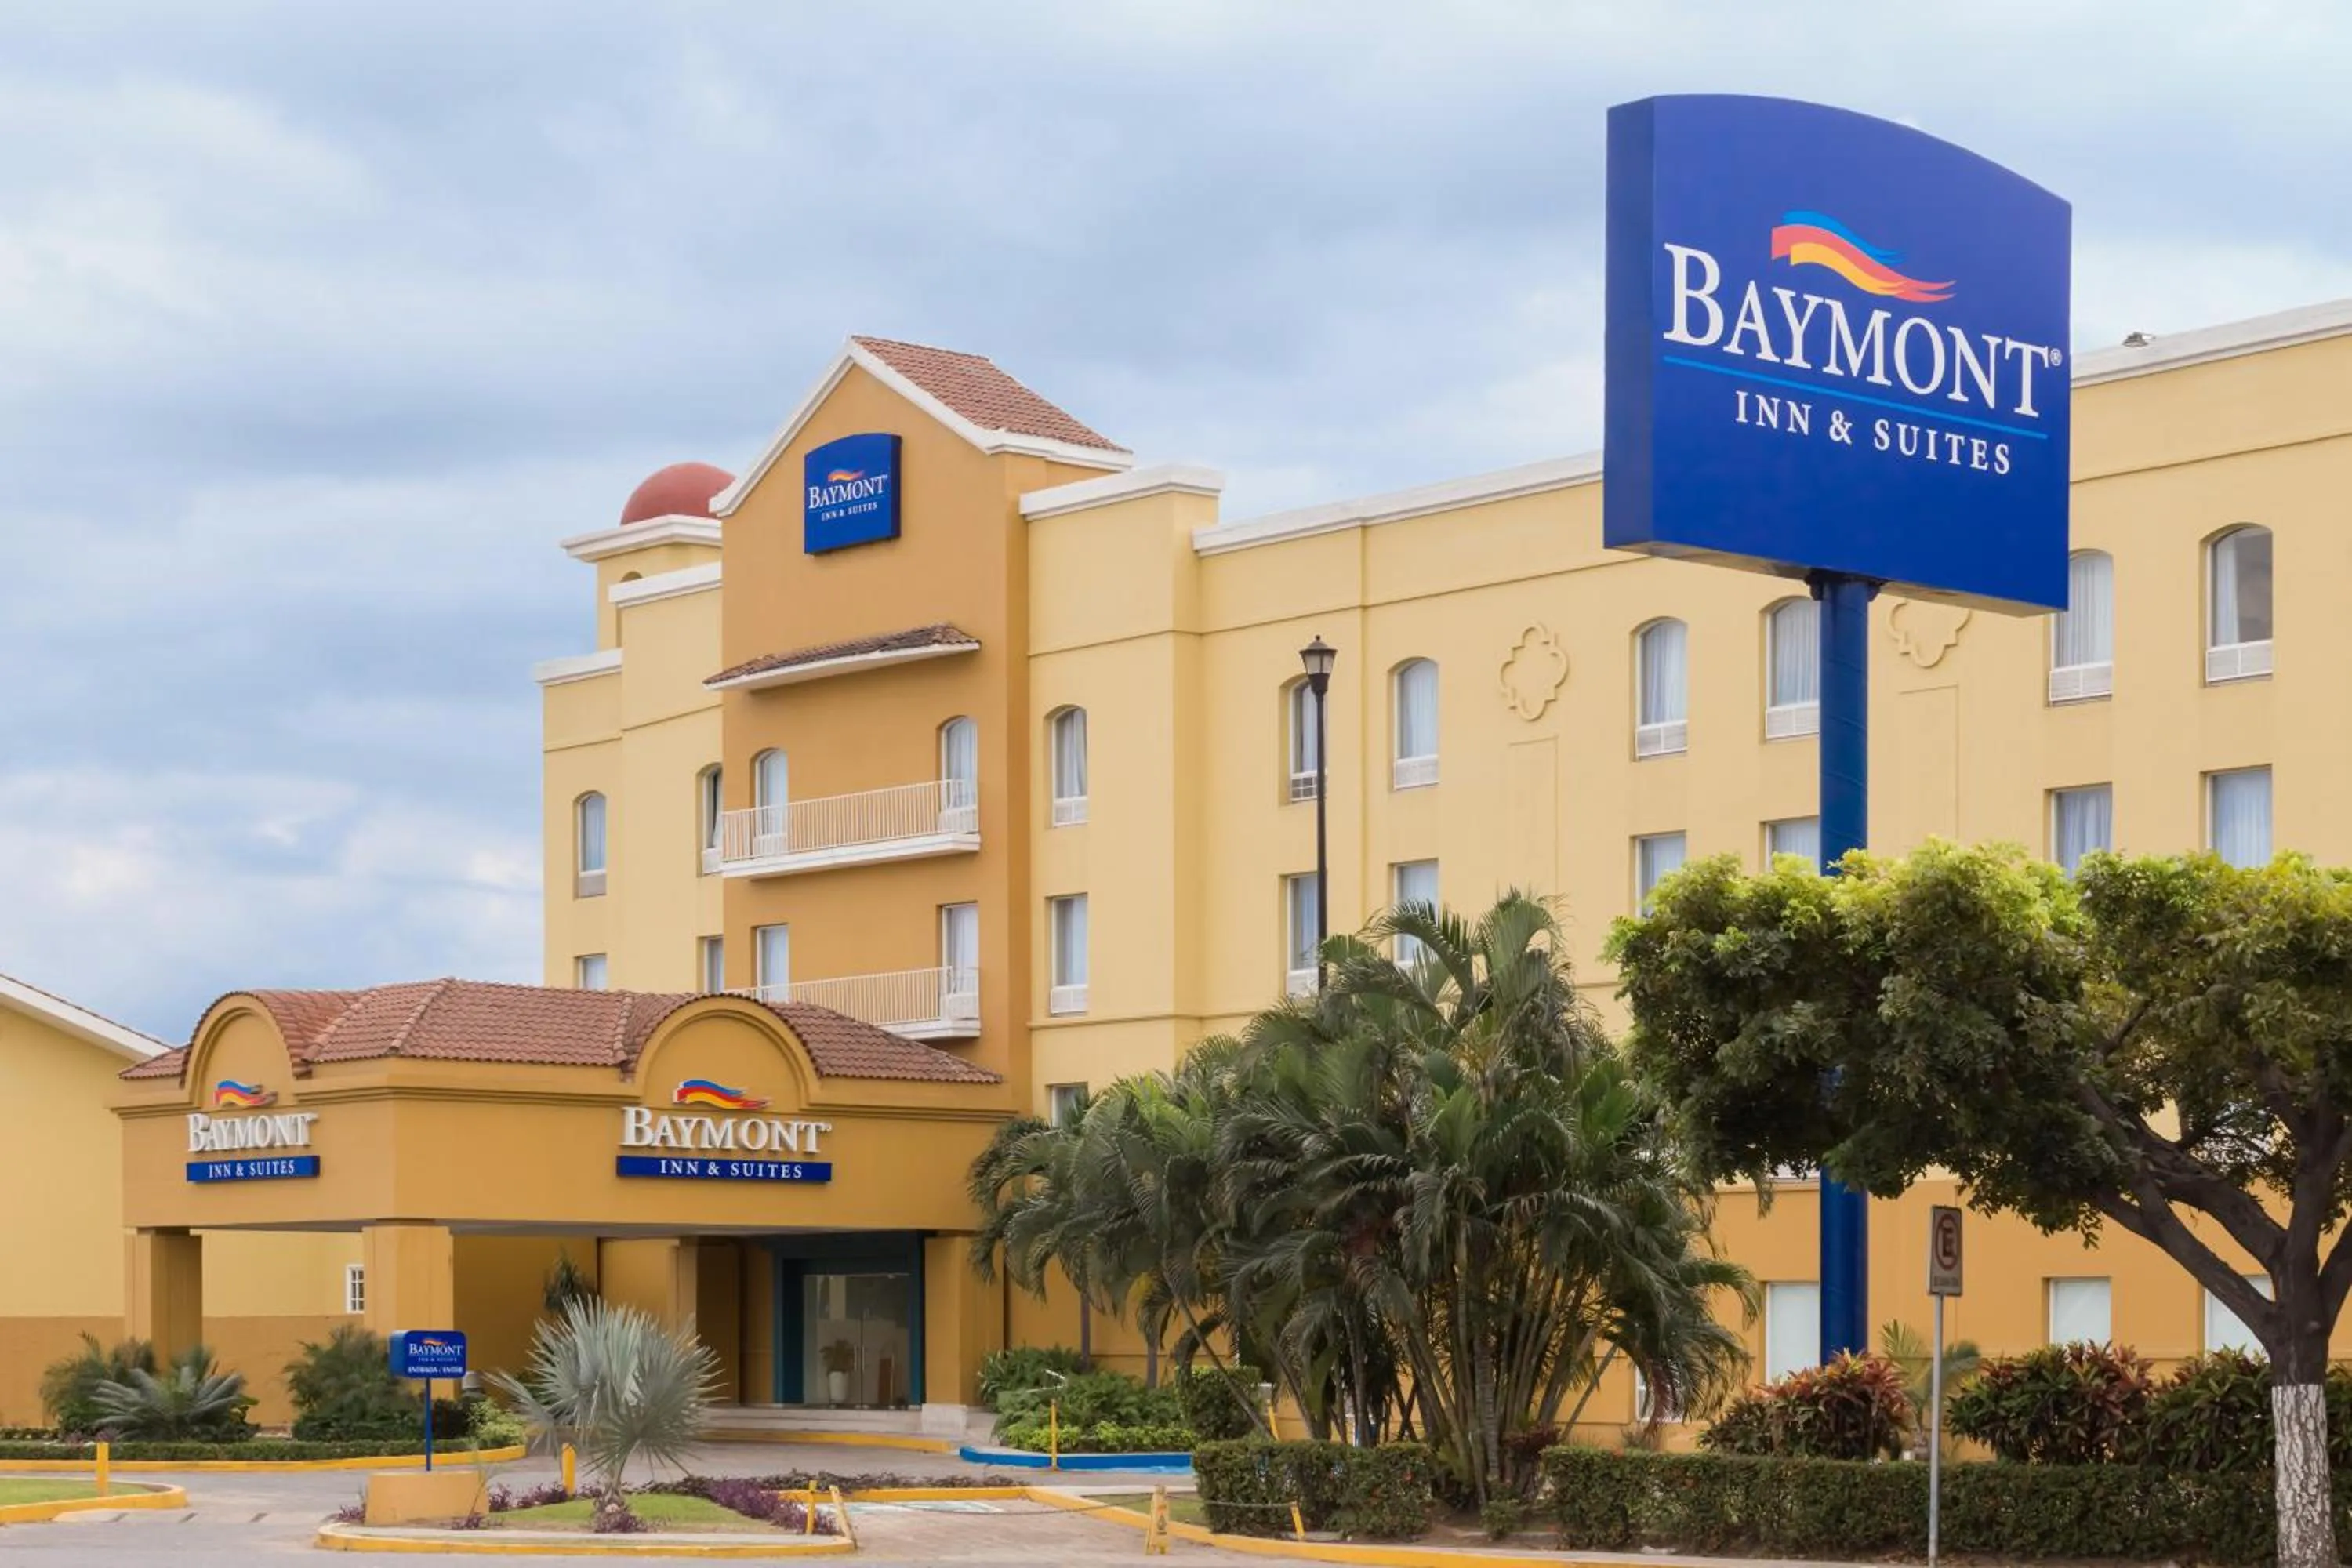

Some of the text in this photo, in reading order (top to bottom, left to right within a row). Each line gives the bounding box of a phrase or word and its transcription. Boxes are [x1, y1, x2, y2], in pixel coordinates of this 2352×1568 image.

[1735, 390, 2010, 475] INN & SUITES
[821, 512, 837, 521] INN
[848, 502, 877, 515] SUITES
[187, 1112, 317, 1152] BAYMONT
[209, 1160, 295, 1178] INN & SUITES
[660, 1160, 803, 1179] INN & SUITES
[409, 1343, 463, 1356] BAYMONT
